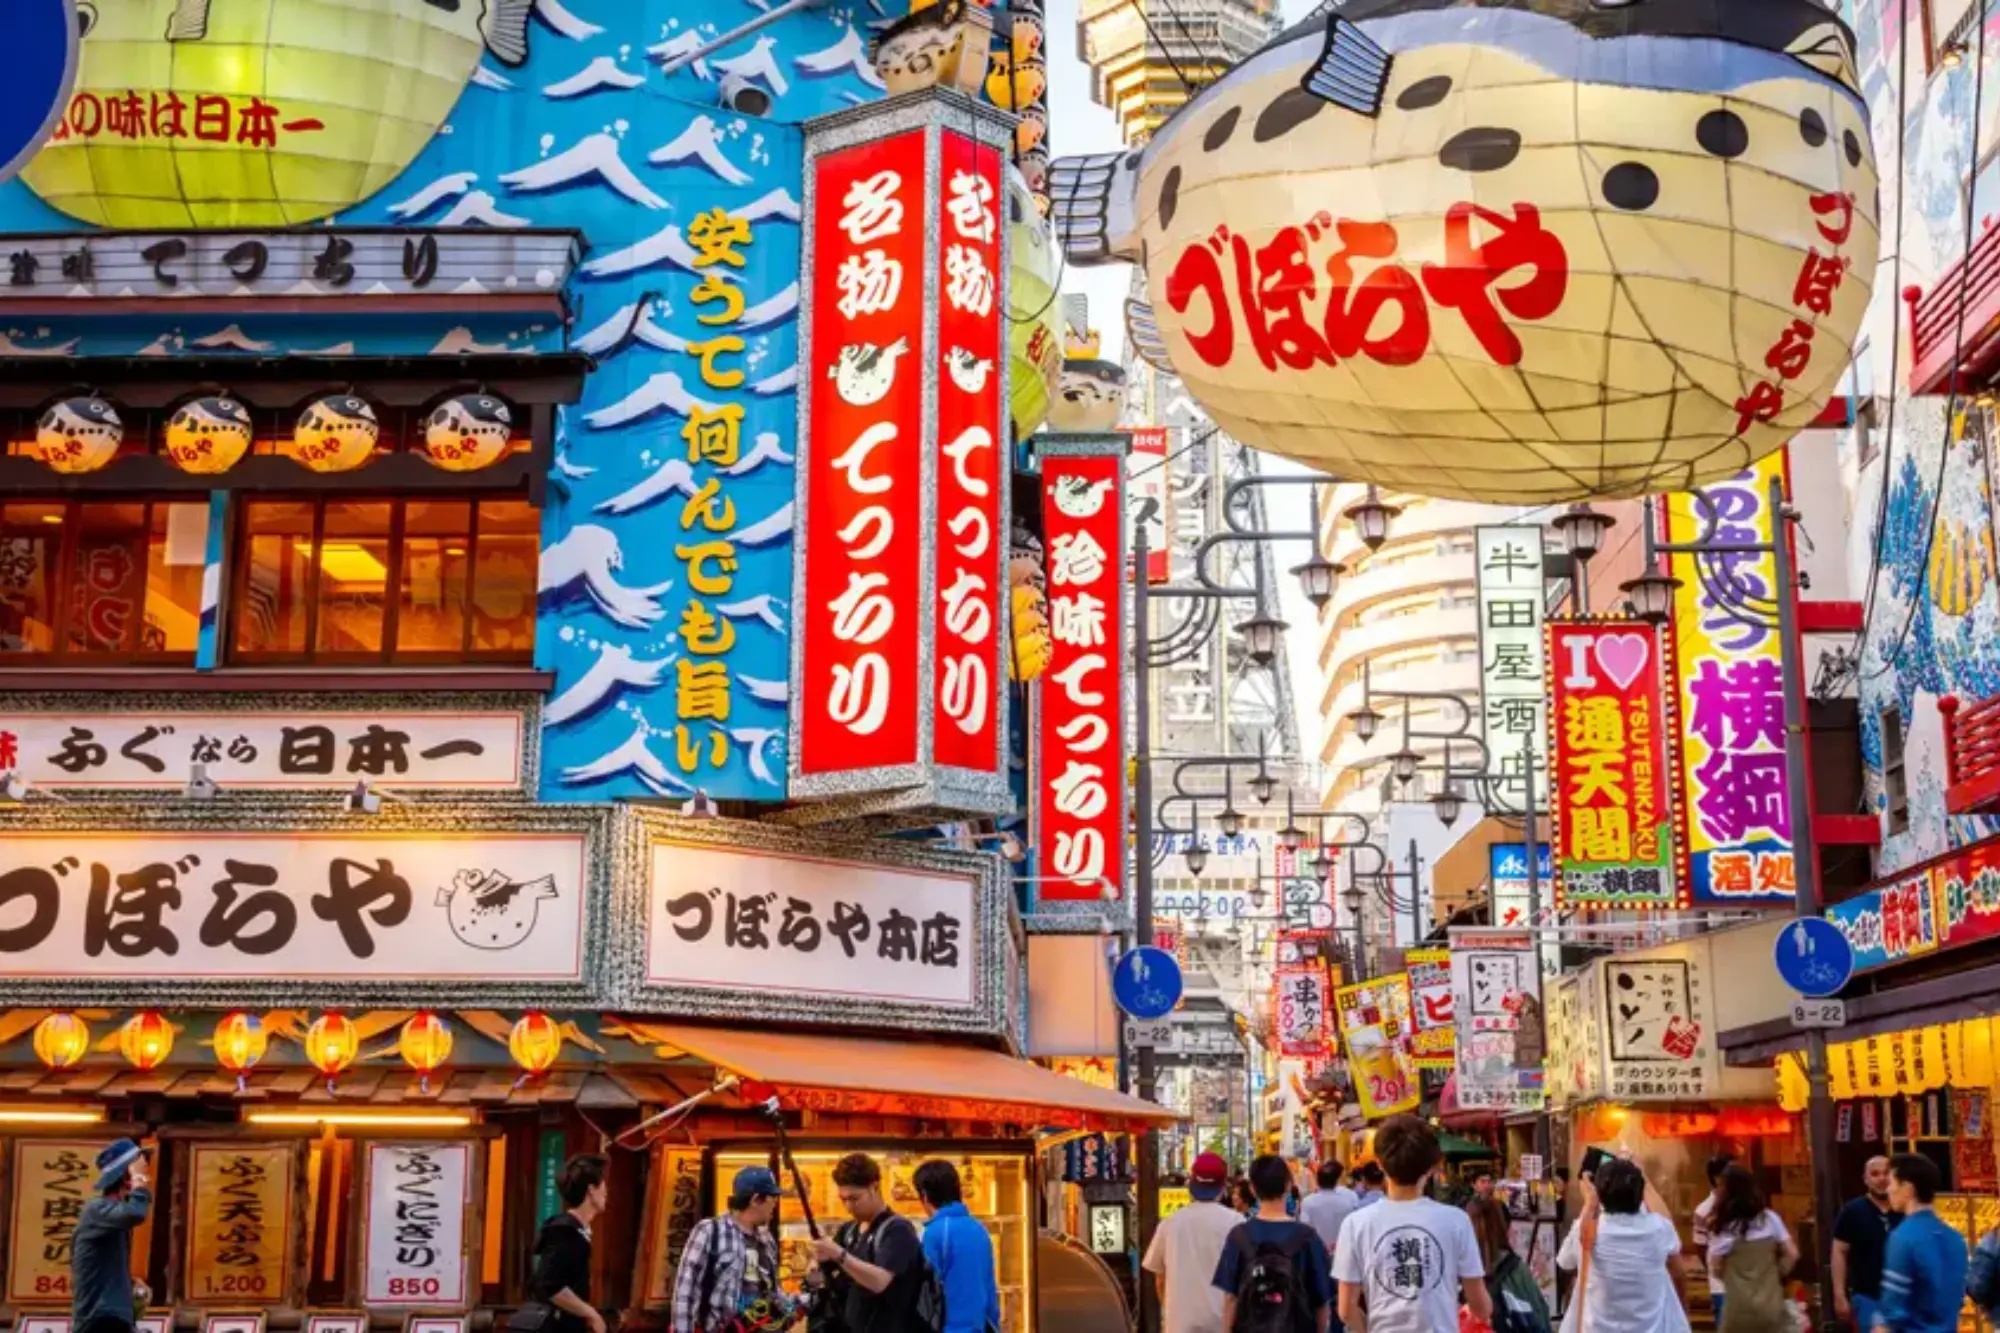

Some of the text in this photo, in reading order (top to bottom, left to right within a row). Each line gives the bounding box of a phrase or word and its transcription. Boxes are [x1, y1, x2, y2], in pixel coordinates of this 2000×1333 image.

[53, 90, 325, 147] の味は日本一
[1166, 202, 1567, 371] づぼらや
[1734, 190, 1856, 436] づぼらや
[827, 168, 904, 736] 名物 てっちり
[941, 425, 993, 738] てっちり
[1051, 529, 1108, 888] 珍味てっちり
[1628, 696, 1657, 861] TSUTENKAKU
[0, 852, 413, 959] づぼらや
[665, 887, 960, 967] づぼらや本店
[35, 1275, 73, 1294] 84
[388, 1277, 440, 1295] 850
